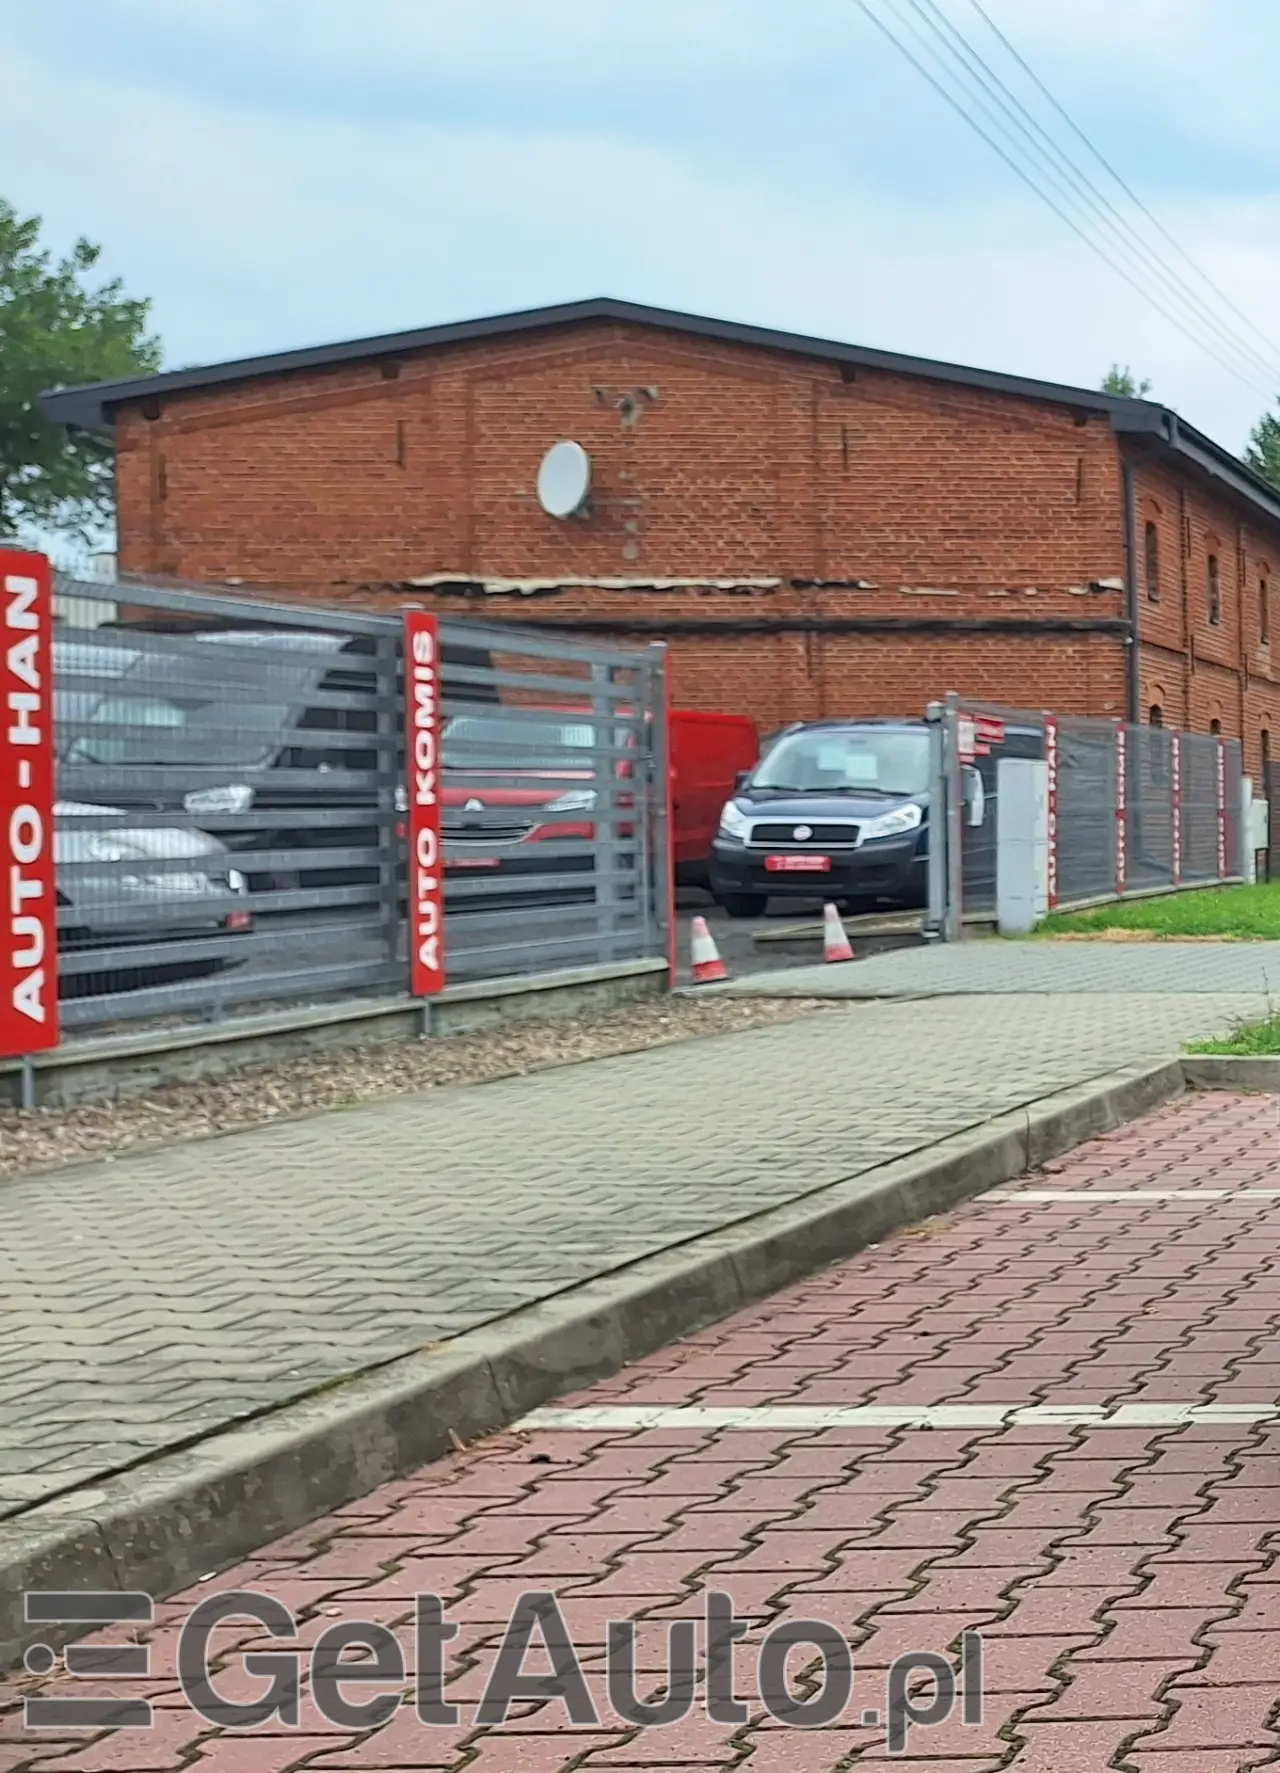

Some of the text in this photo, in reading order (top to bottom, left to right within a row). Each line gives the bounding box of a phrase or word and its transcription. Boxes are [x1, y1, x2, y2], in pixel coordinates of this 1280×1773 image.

[8, 803, 46, 1024] AUTO
[412, 629, 441, 971] AUTO KOMIS
